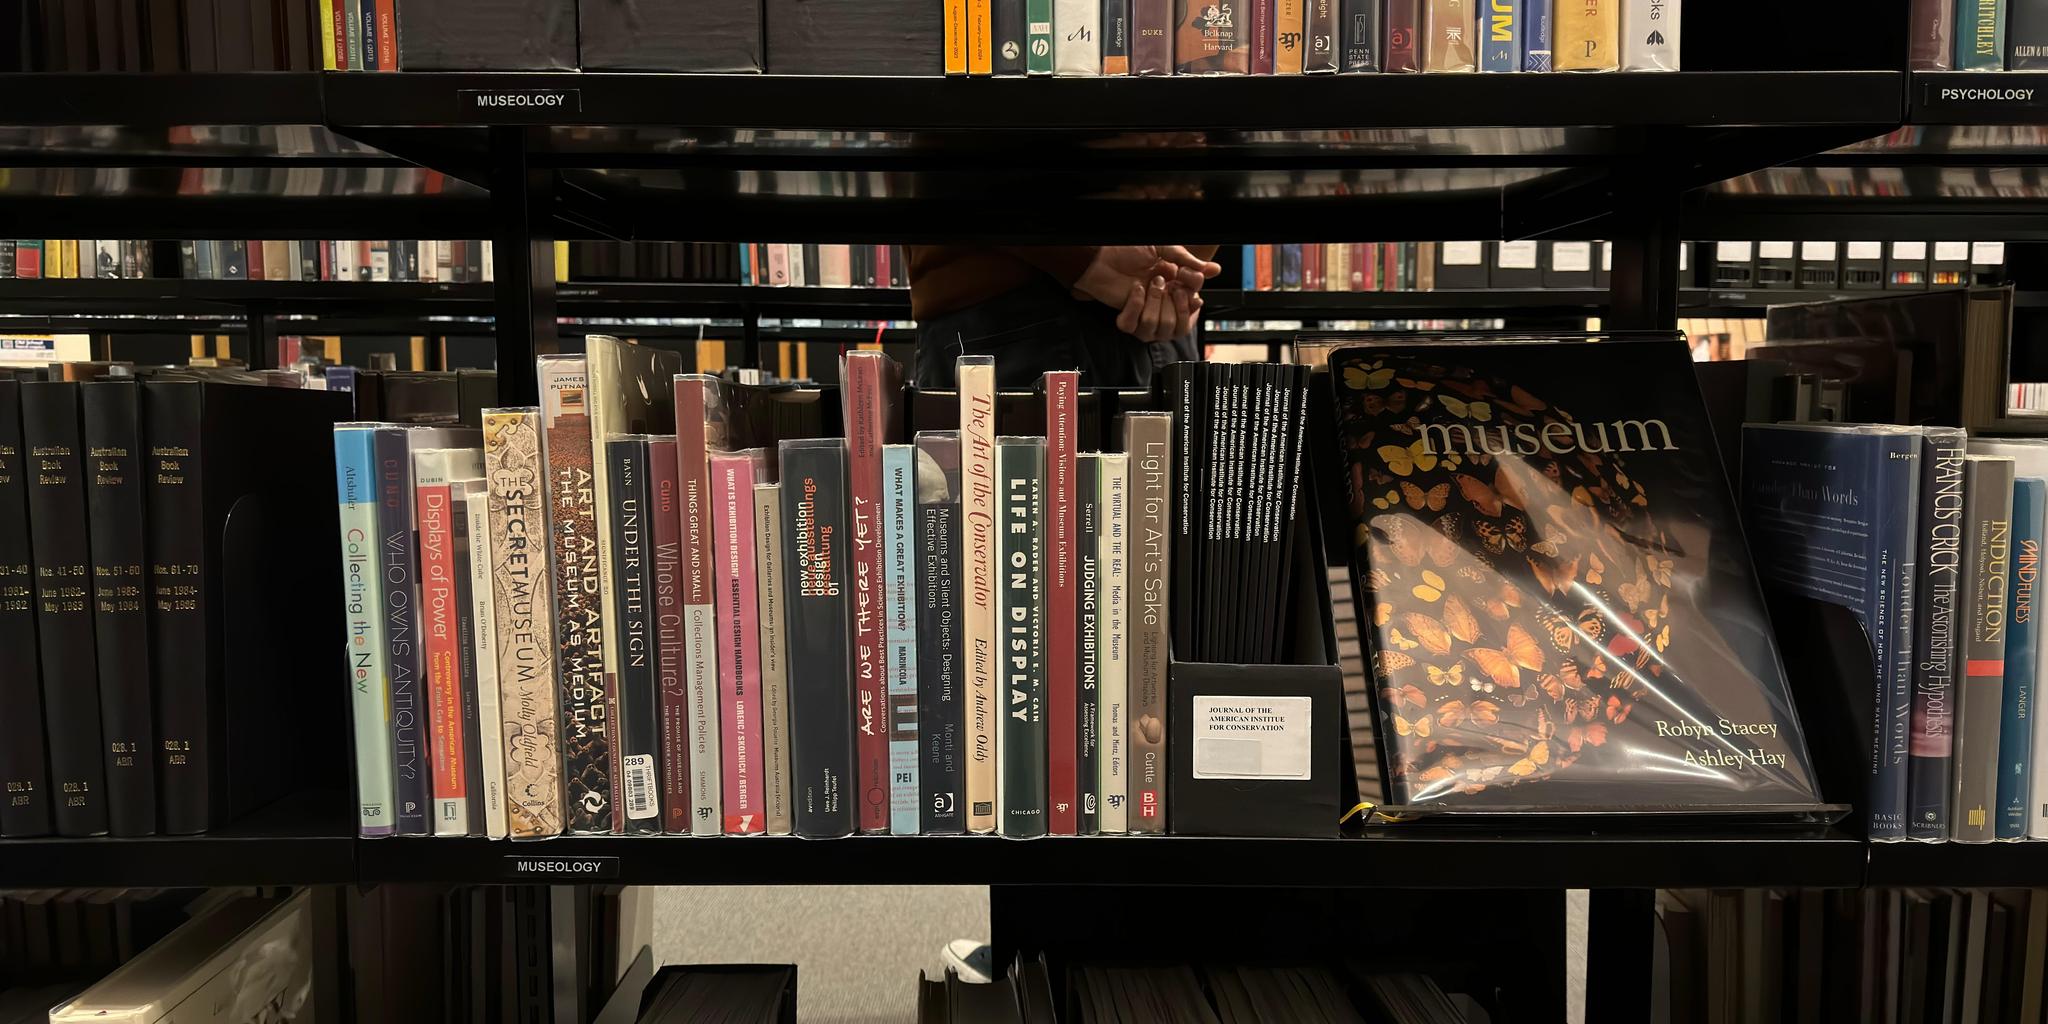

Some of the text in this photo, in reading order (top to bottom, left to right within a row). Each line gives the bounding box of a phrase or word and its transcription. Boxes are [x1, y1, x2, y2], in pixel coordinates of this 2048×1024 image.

[1204, 30, 1233, 39] Belknap
[477, 94, 565, 106] MUSEOLOGY
[1941, 89, 2034, 100] PSYCHOLOGY
[32, 446, 71, 456] Australian
[152, 446, 189, 456] Australian
[1415, 418, 1680, 457] museum
[1890, 452, 1918, 461] Bergen
[40, 475, 66, 485] Review
[42, 460, 62, 470] Book
[157, 474, 184, 484] Review
[160, 460, 180, 470] Book
[384, 460, 400, 510] CUNO
[501, 478, 528, 486] THE
[623, 458, 632, 486] BANN
[895, 468, 904, 496] WHAT
[1057, 381, 1068, 588] Paying Attention: Visitors and Museum Exhibitions
[346, 466, 357, 510] Altshuler
[660, 480, 671, 512] Cuno
[966, 394, 992, 610] The Art of the Conservator
[726, 468, 739, 577] WHAT IS EXHIBITION DESIGN?
[896, 498, 904, 530] MAKES
[1085, 503, 1094, 534] Serrell
[1142, 442, 1164, 625] Light for Art's Sake
[1182, 493, 1190, 534] Conservation
[476, 544, 484, 562] White
[688, 479, 702, 602] THINGS GREAT AND SMALL:
[896, 542, 904, 572] GREAT
[927, 508, 938, 608] Effective Exhibitions
[423, 494, 448, 640] Displays of Power
[622, 500, 644, 668] UNDER THE SIGN
[1984, 520, 2008, 644] INDUCTION
[2015, 540, 2039, 624] MINDFULNESS
[348, 528, 372, 693] Collecting the New
[560, 466, 586, 738] THE MUSEUM AS MEDIUM
[576, 468, 606, 738] ART AND ARTIFACT
[897, 574, 906, 631] EXHIBITION?
[940, 508, 953, 702] Museums and Silent Objects: Designing
[1011, 478, 1028, 722] LIFE ON DISPLAY
[1918, 448, 1964, 738] FRANCIS CRICK The Astonishing Hypothesis
[656, 542, 683, 696] Whose Culture?
[854, 496, 874, 736] ARE WE THERE YET?
[1084, 556, 1096, 690] JUDGING EXHIBITIONS
[386, 530, 416, 780] WHO OWNS ANTIQUITY?
[898, 646, 907, 685] MARINCOLA
[694, 610, 708, 754] Collections Management Policies
[972, 638, 989, 763] Edited by Andrew Oddy
[2018, 686, 2027, 719] LANGER
[518, 686, 538, 768] Molly Oldfield
[1656, 720, 1778, 740] Robyn Stacey
[897, 774, 912, 782] PEI
[1145, 752, 1156, 783] Cuttle
[1684, 749, 1786, 770] Ashley Hay
[490, 782, 498, 810] California
[645, 765, 655, 807] THRIFTBOOKS
[518, 861, 601, 872] MUSEOLOGY
